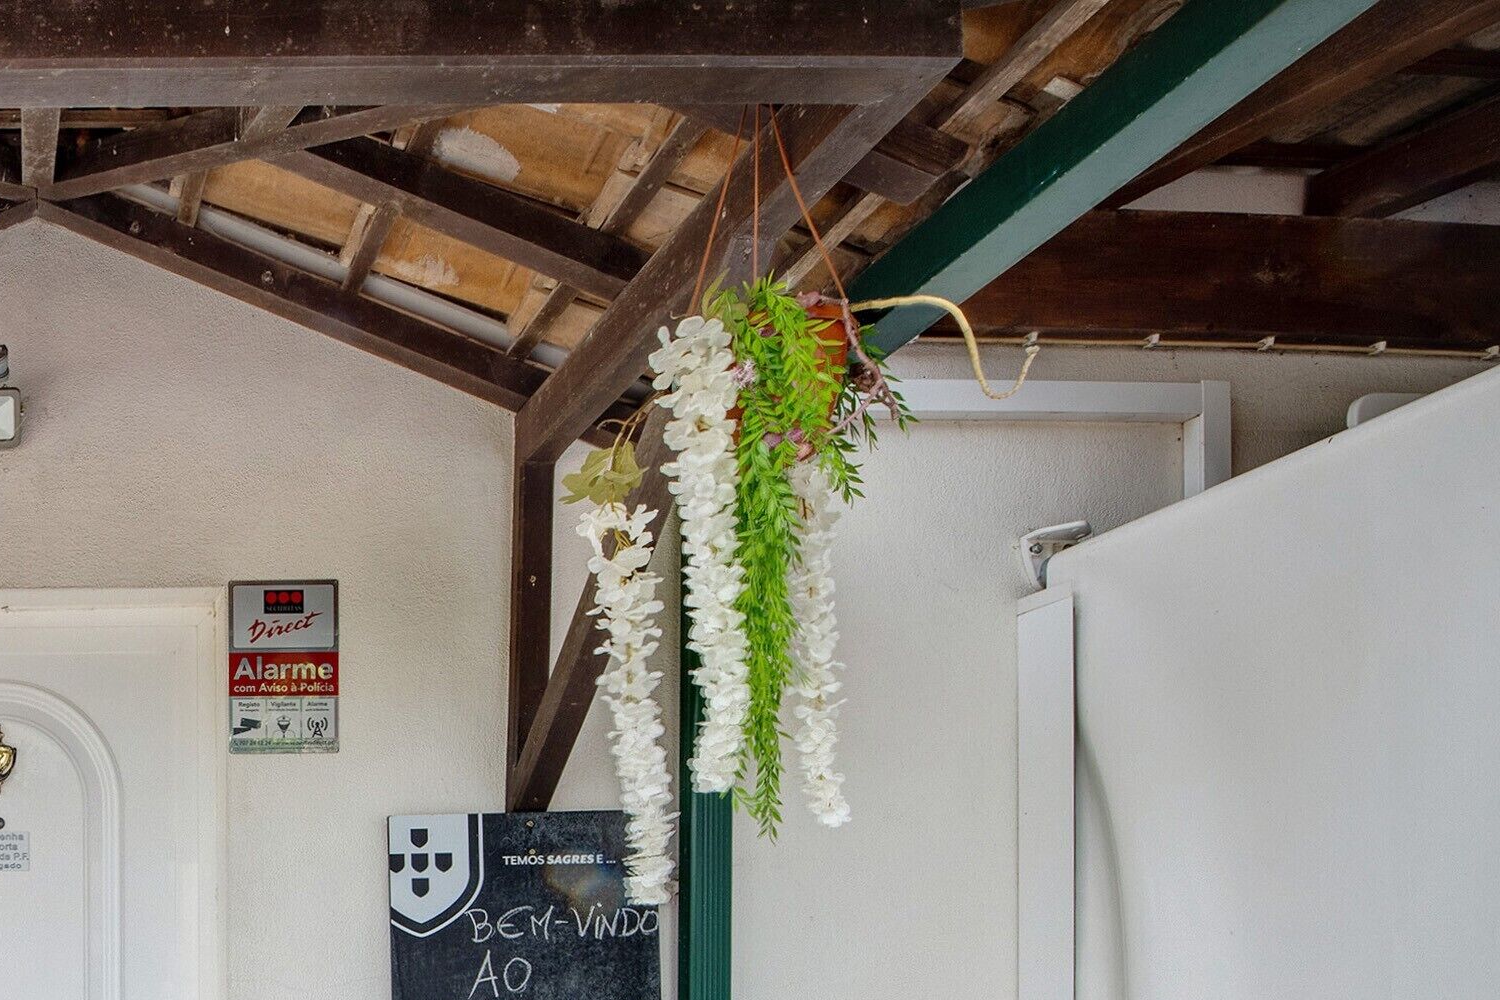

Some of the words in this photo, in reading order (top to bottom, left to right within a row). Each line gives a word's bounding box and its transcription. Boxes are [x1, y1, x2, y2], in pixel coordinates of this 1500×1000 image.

[247, 611, 323, 644] Direct
[233, 657, 333, 680] Alarme
[233, 685, 256, 693] com
[259, 682, 287, 693] Aviso
[300, 682, 334, 693] Polícia
[502, 855, 545, 866] TEMOS
[546, 854, 595, 865] SAGRES
[467, 949, 533, 999] AO
